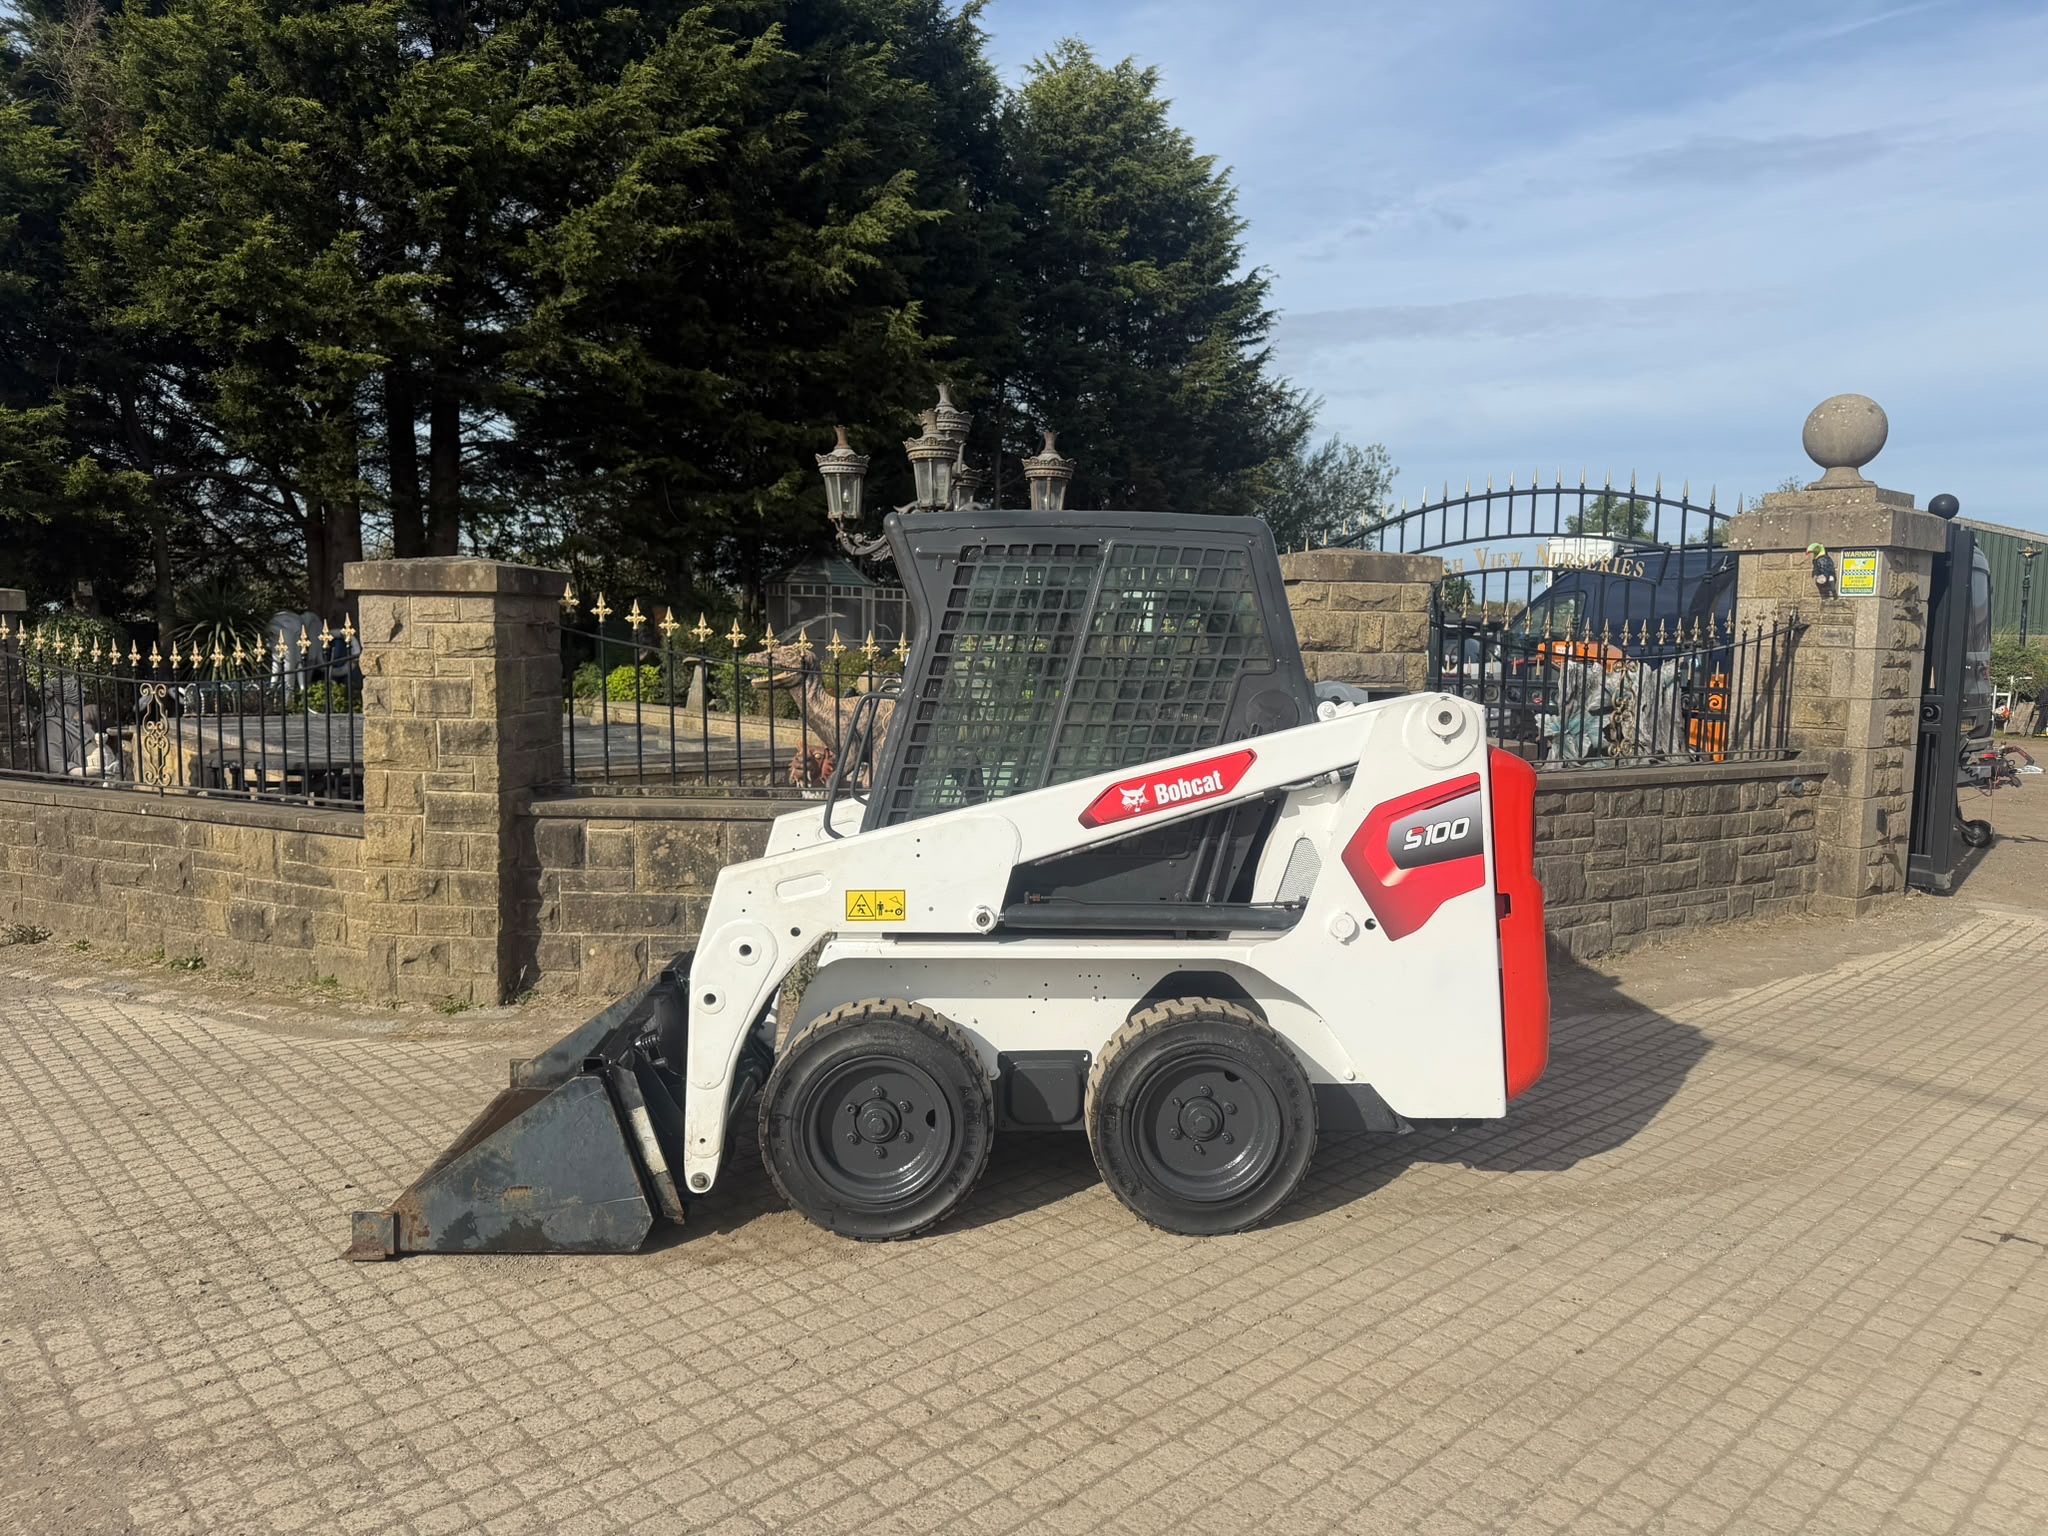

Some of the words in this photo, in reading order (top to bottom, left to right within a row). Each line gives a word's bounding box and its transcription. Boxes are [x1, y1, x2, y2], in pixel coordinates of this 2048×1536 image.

[1474, 546, 1523, 570] VIEW
[1536, 543, 1646, 578] NURSERIES
[1154, 770, 1223, 805] Bobcat
[1403, 817, 1470, 850] S100
